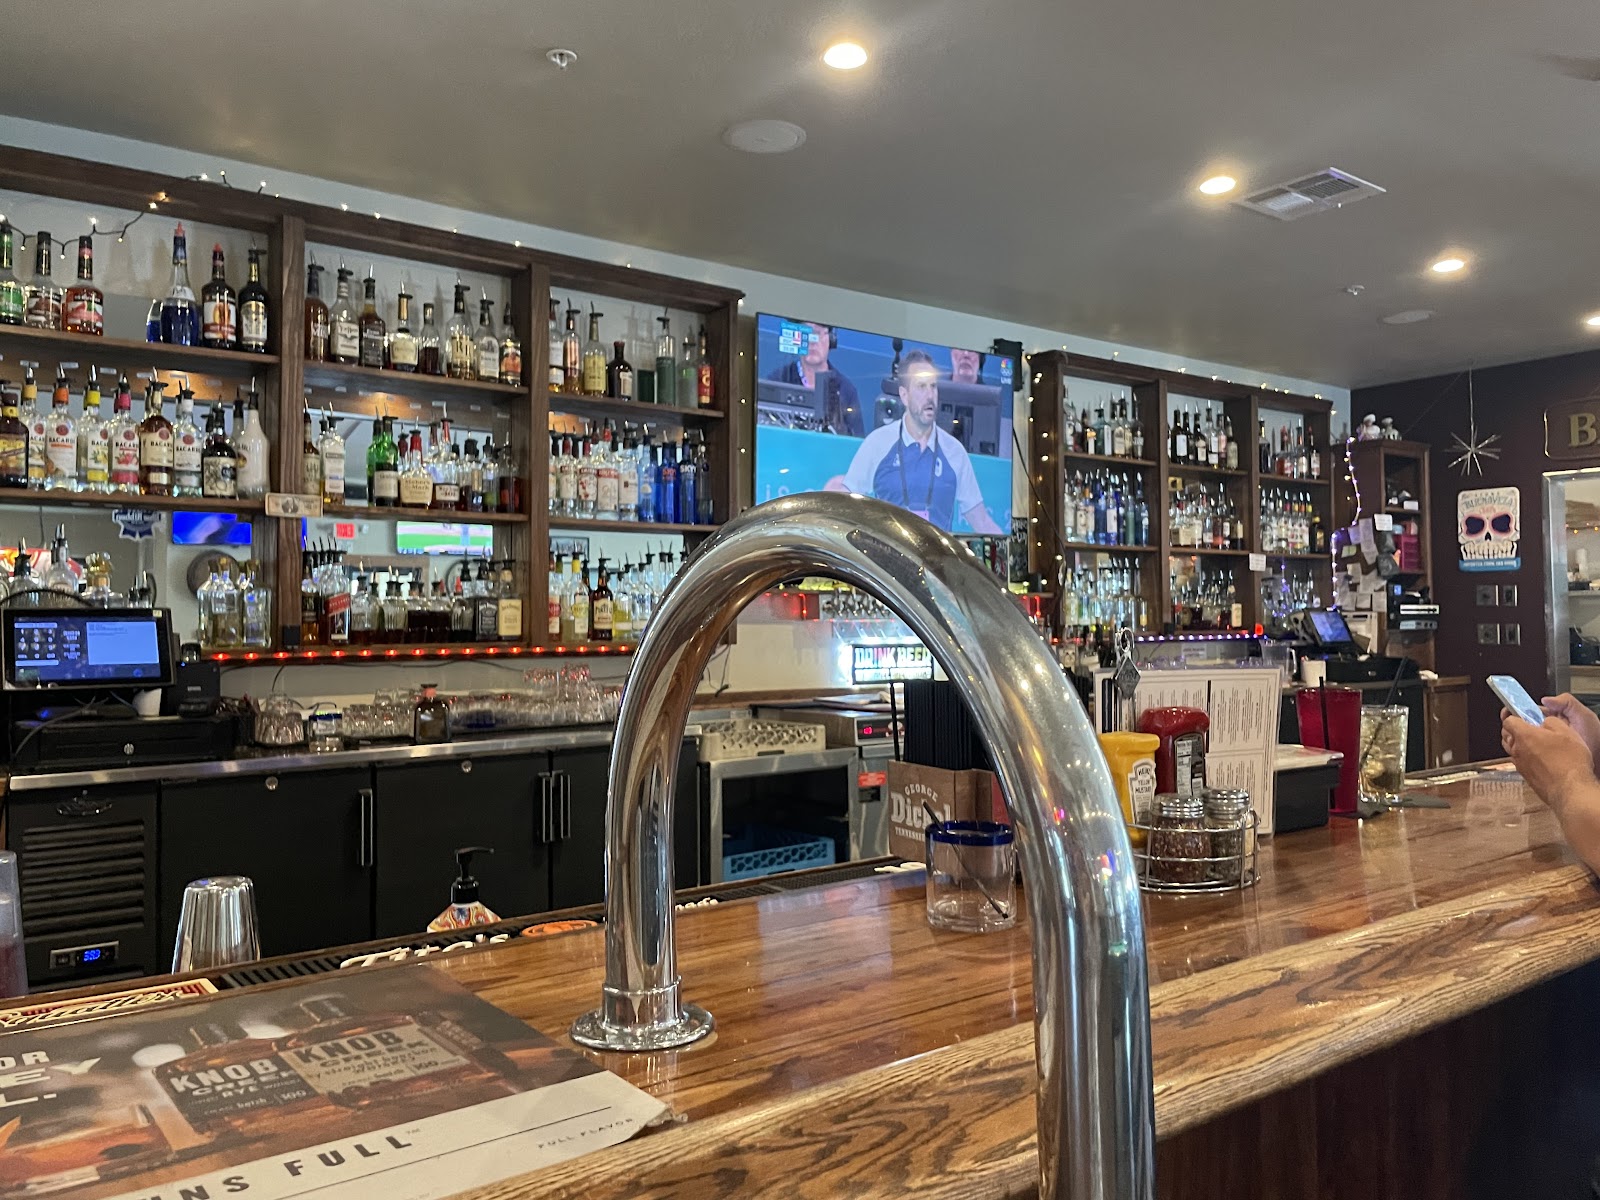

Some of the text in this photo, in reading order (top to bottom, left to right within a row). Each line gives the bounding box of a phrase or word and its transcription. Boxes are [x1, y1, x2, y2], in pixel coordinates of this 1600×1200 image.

[1568, 412, 1600, 448] B
[854, 645, 933, 669] DRINK BEER
[904, 783, 938, 802] GEORGE
[890, 791, 951, 830] Dickl
[292, 1031, 404, 1064] KNOB
[170, 1058, 279, 1093] KNOB
[192, 1070, 297, 1097] CREEK
[538, 1118, 633, 1149] FULL FLAVOR
